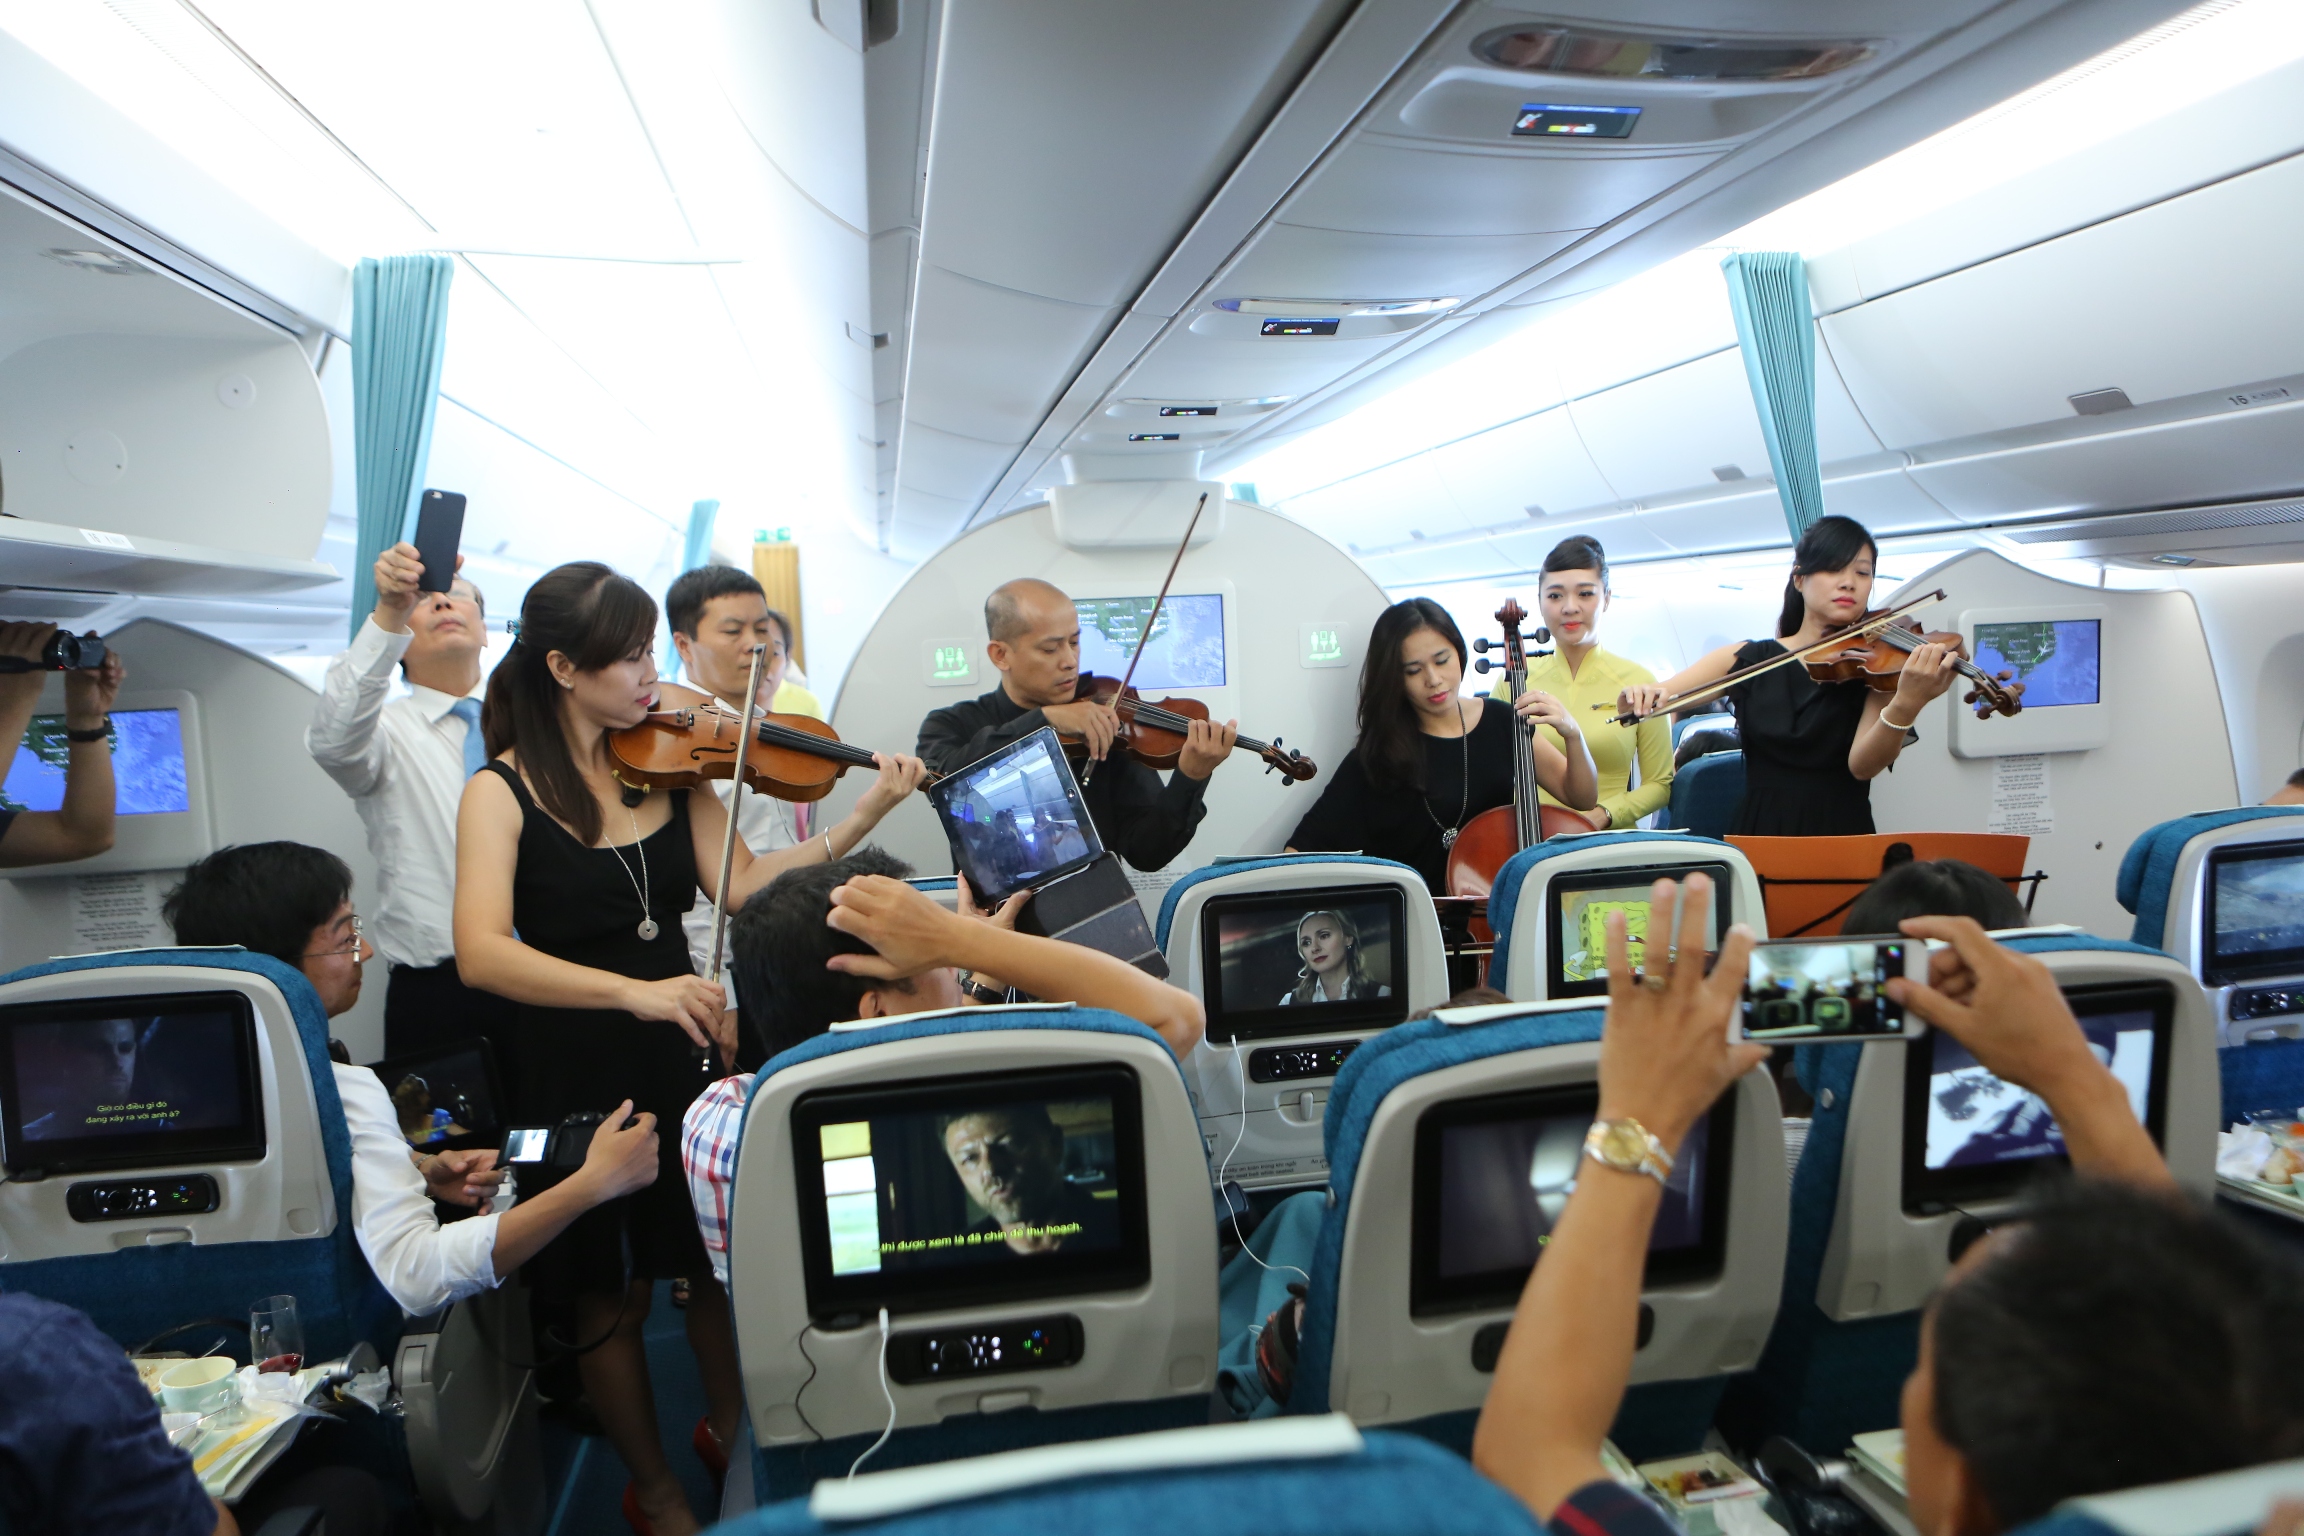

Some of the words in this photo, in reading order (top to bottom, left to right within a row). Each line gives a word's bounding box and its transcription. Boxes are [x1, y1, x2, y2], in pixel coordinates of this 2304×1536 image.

[2228, 395, 2249, 406] 16
[928, 1236, 951, 1249] xem
[1026, 1225, 1044, 1238] thu
